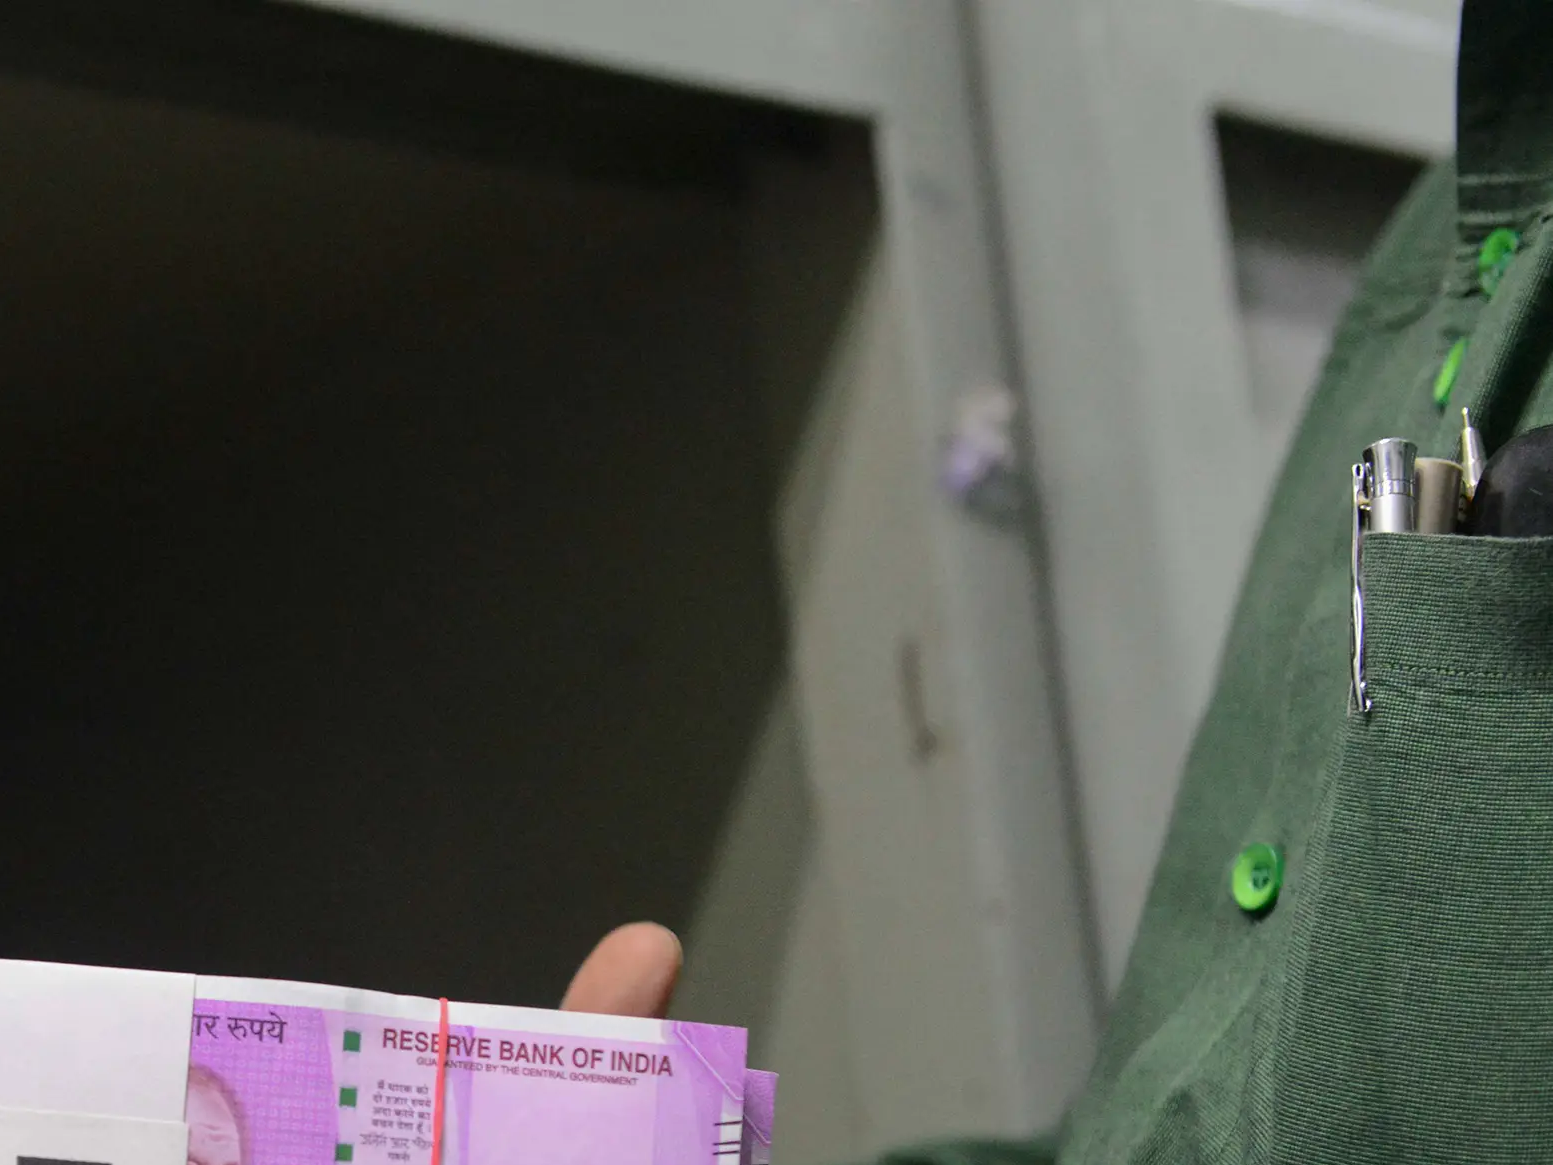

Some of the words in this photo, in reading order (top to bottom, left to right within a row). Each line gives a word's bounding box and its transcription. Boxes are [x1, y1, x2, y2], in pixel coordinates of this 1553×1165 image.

[382, 1027, 492, 1059] RESERVE
[498, 1039, 565, 1067] BANK
[572, 1047, 605, 1070] OF
[610, 1050, 674, 1077] INDIA
[415, 1056, 484, 1073] GUAANTEED
[485, 1063, 499, 1073] BY
[501, 1064, 521, 1076] THE
[522, 1067, 568, 1081] CENTRAL
[569, 1072, 639, 1086] GOVERNMENT
